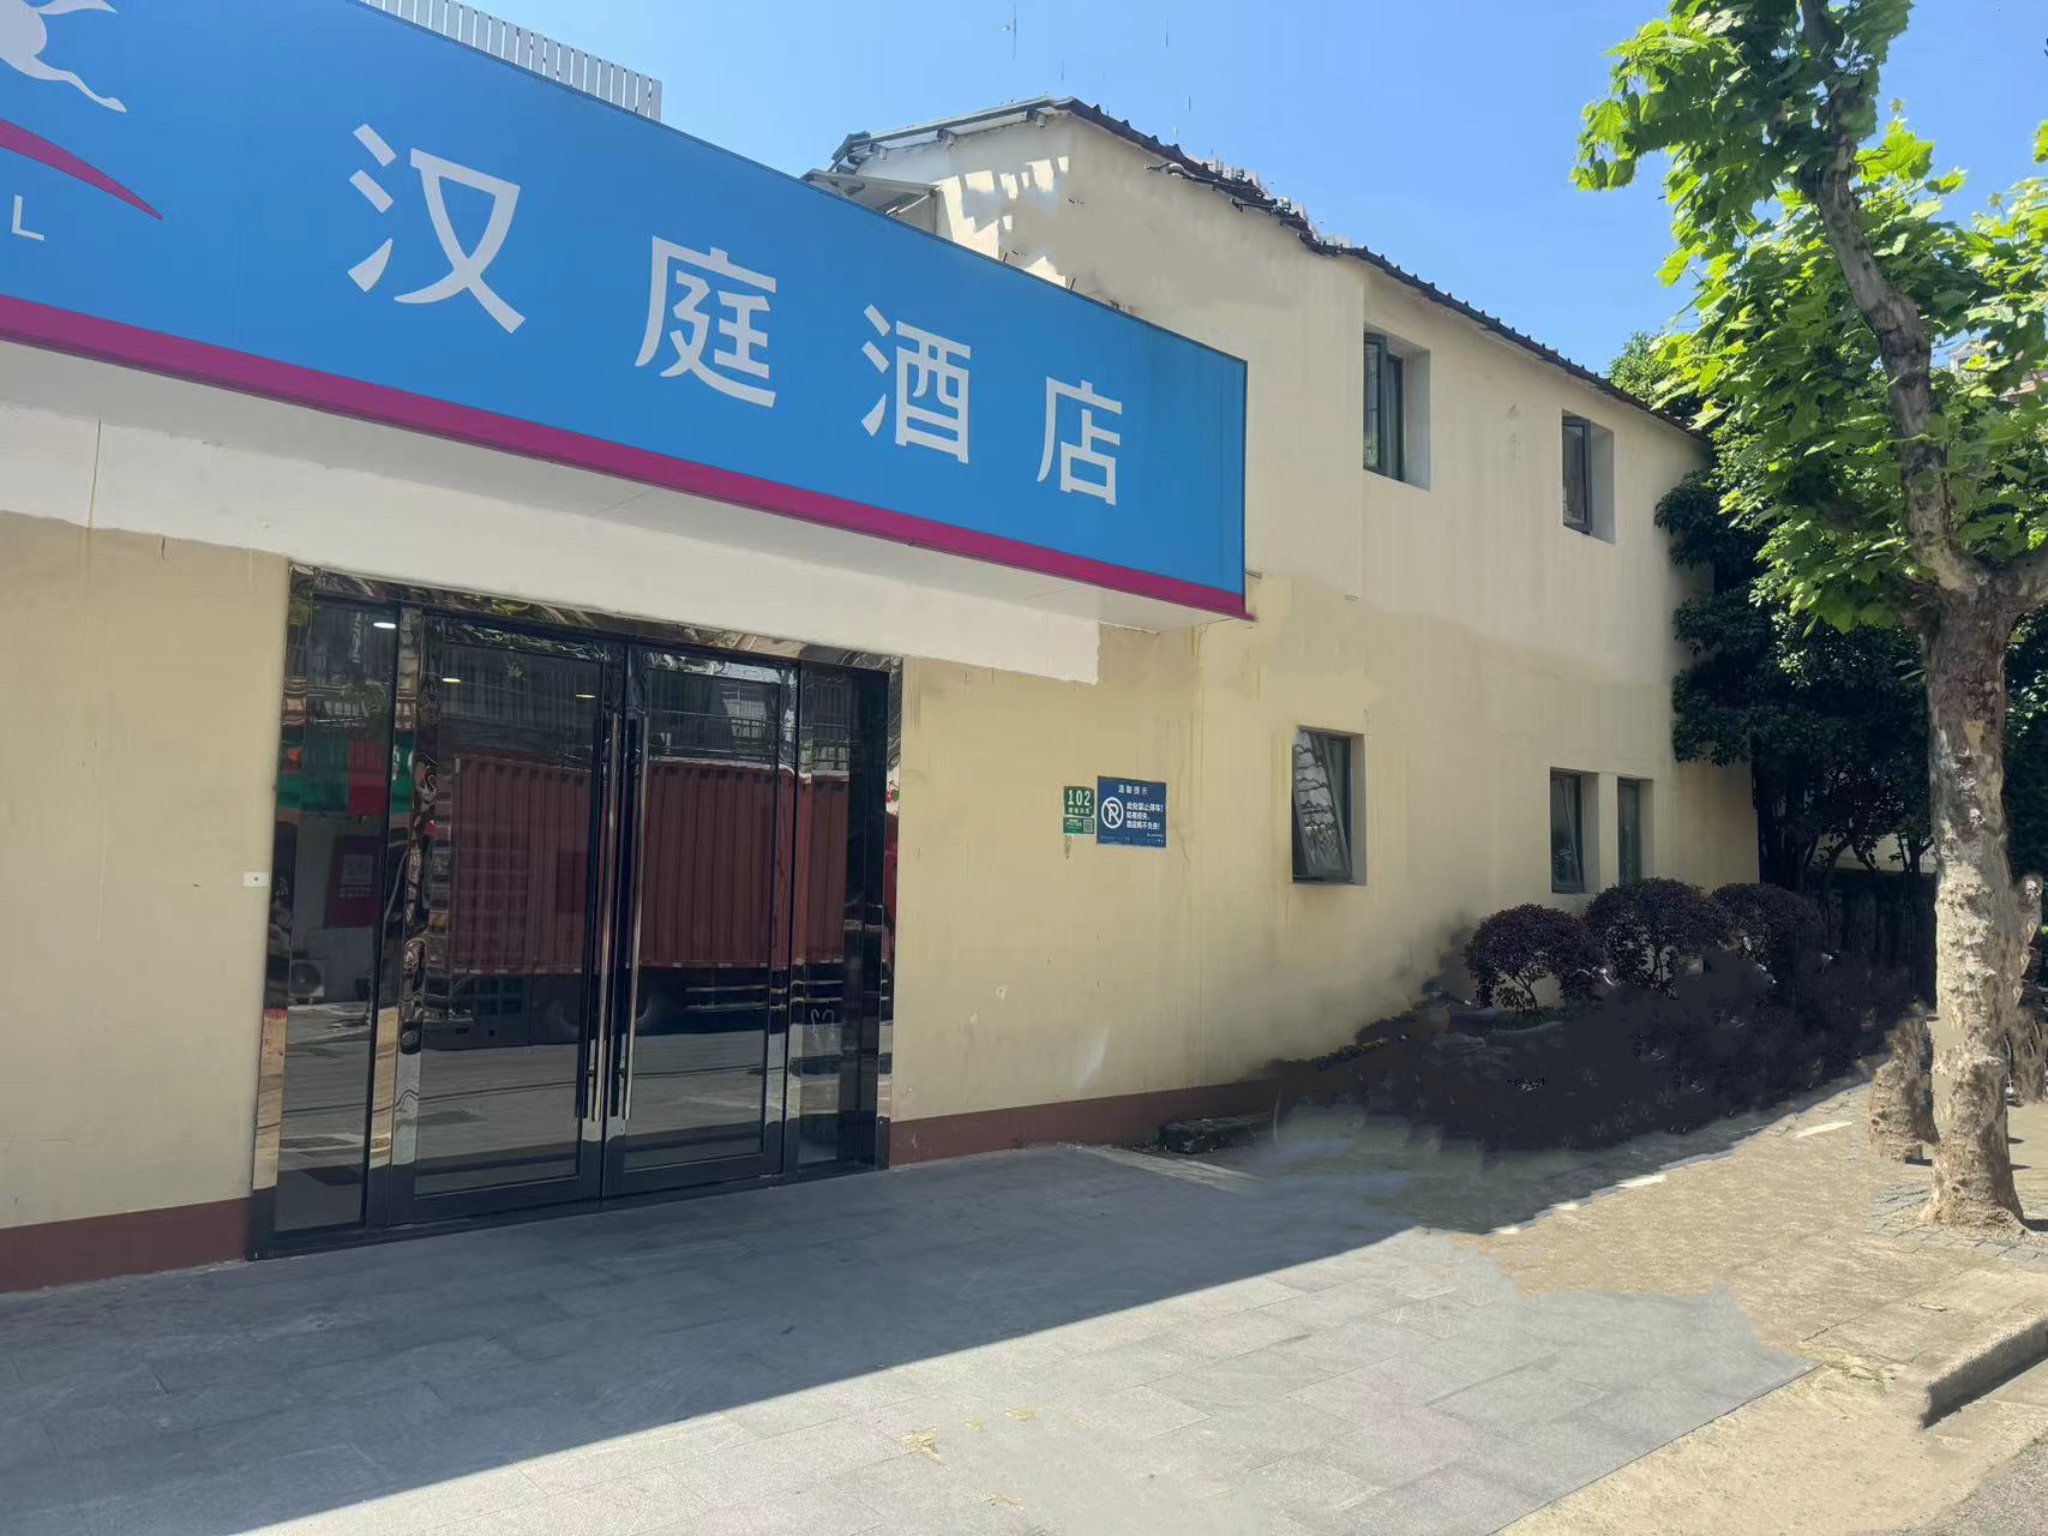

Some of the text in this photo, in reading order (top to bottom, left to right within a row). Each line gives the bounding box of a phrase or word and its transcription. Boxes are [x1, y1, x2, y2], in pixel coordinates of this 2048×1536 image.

[348, 123, 1123, 507] 汉庭酒店
[1067, 789, 1091, 806] 102
